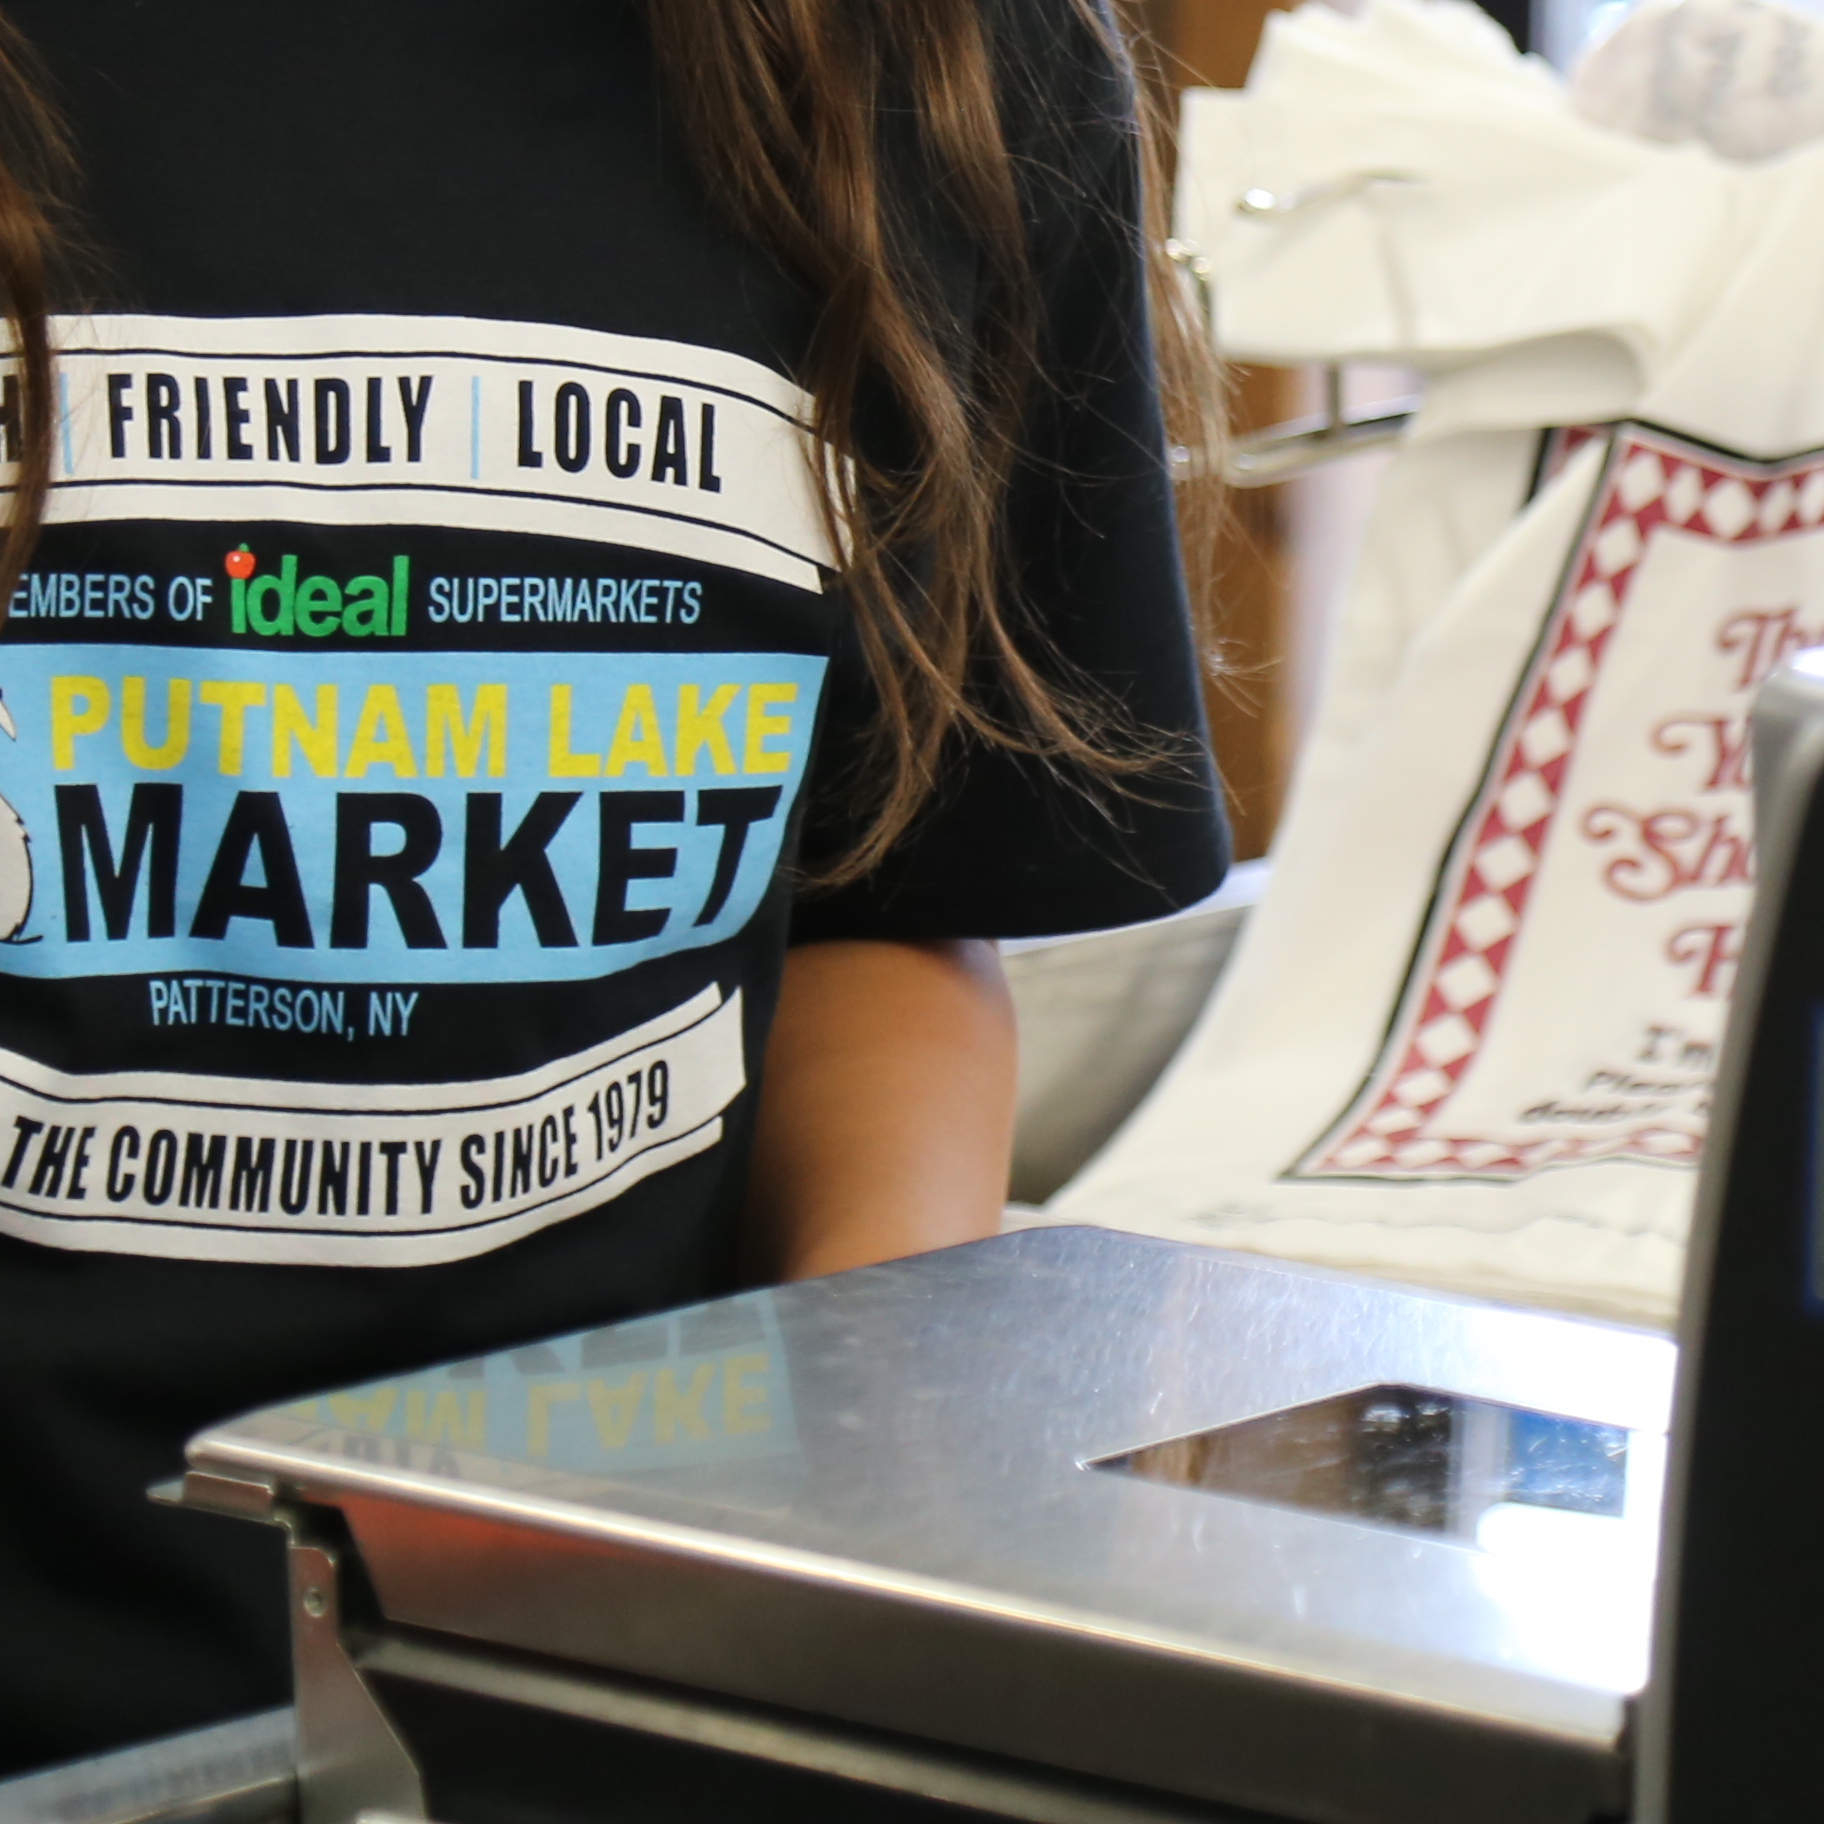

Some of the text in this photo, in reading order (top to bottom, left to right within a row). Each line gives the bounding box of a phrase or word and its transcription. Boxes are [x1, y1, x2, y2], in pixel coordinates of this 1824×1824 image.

[107, 373, 434, 466] FRIENDLY
[517, 379, 722, 494] LOCAL
[166, 576, 214, 622] OF
[224, 542, 410, 638] ideal
[427, 576, 703, 625] SUPERMARKETS
[49, 675, 799, 778] PUTNAM LAKE
[52, 782, 783, 950] MARKET
[148, 978, 419, 1042] PATTERSON, NY
[0, 1114, 96, 1200] THE
[105, 1124, 443, 1216] COMMUNITY
[459, 1104, 580, 1210] SINCE
[587, 1059, 670, 1163] 1979
